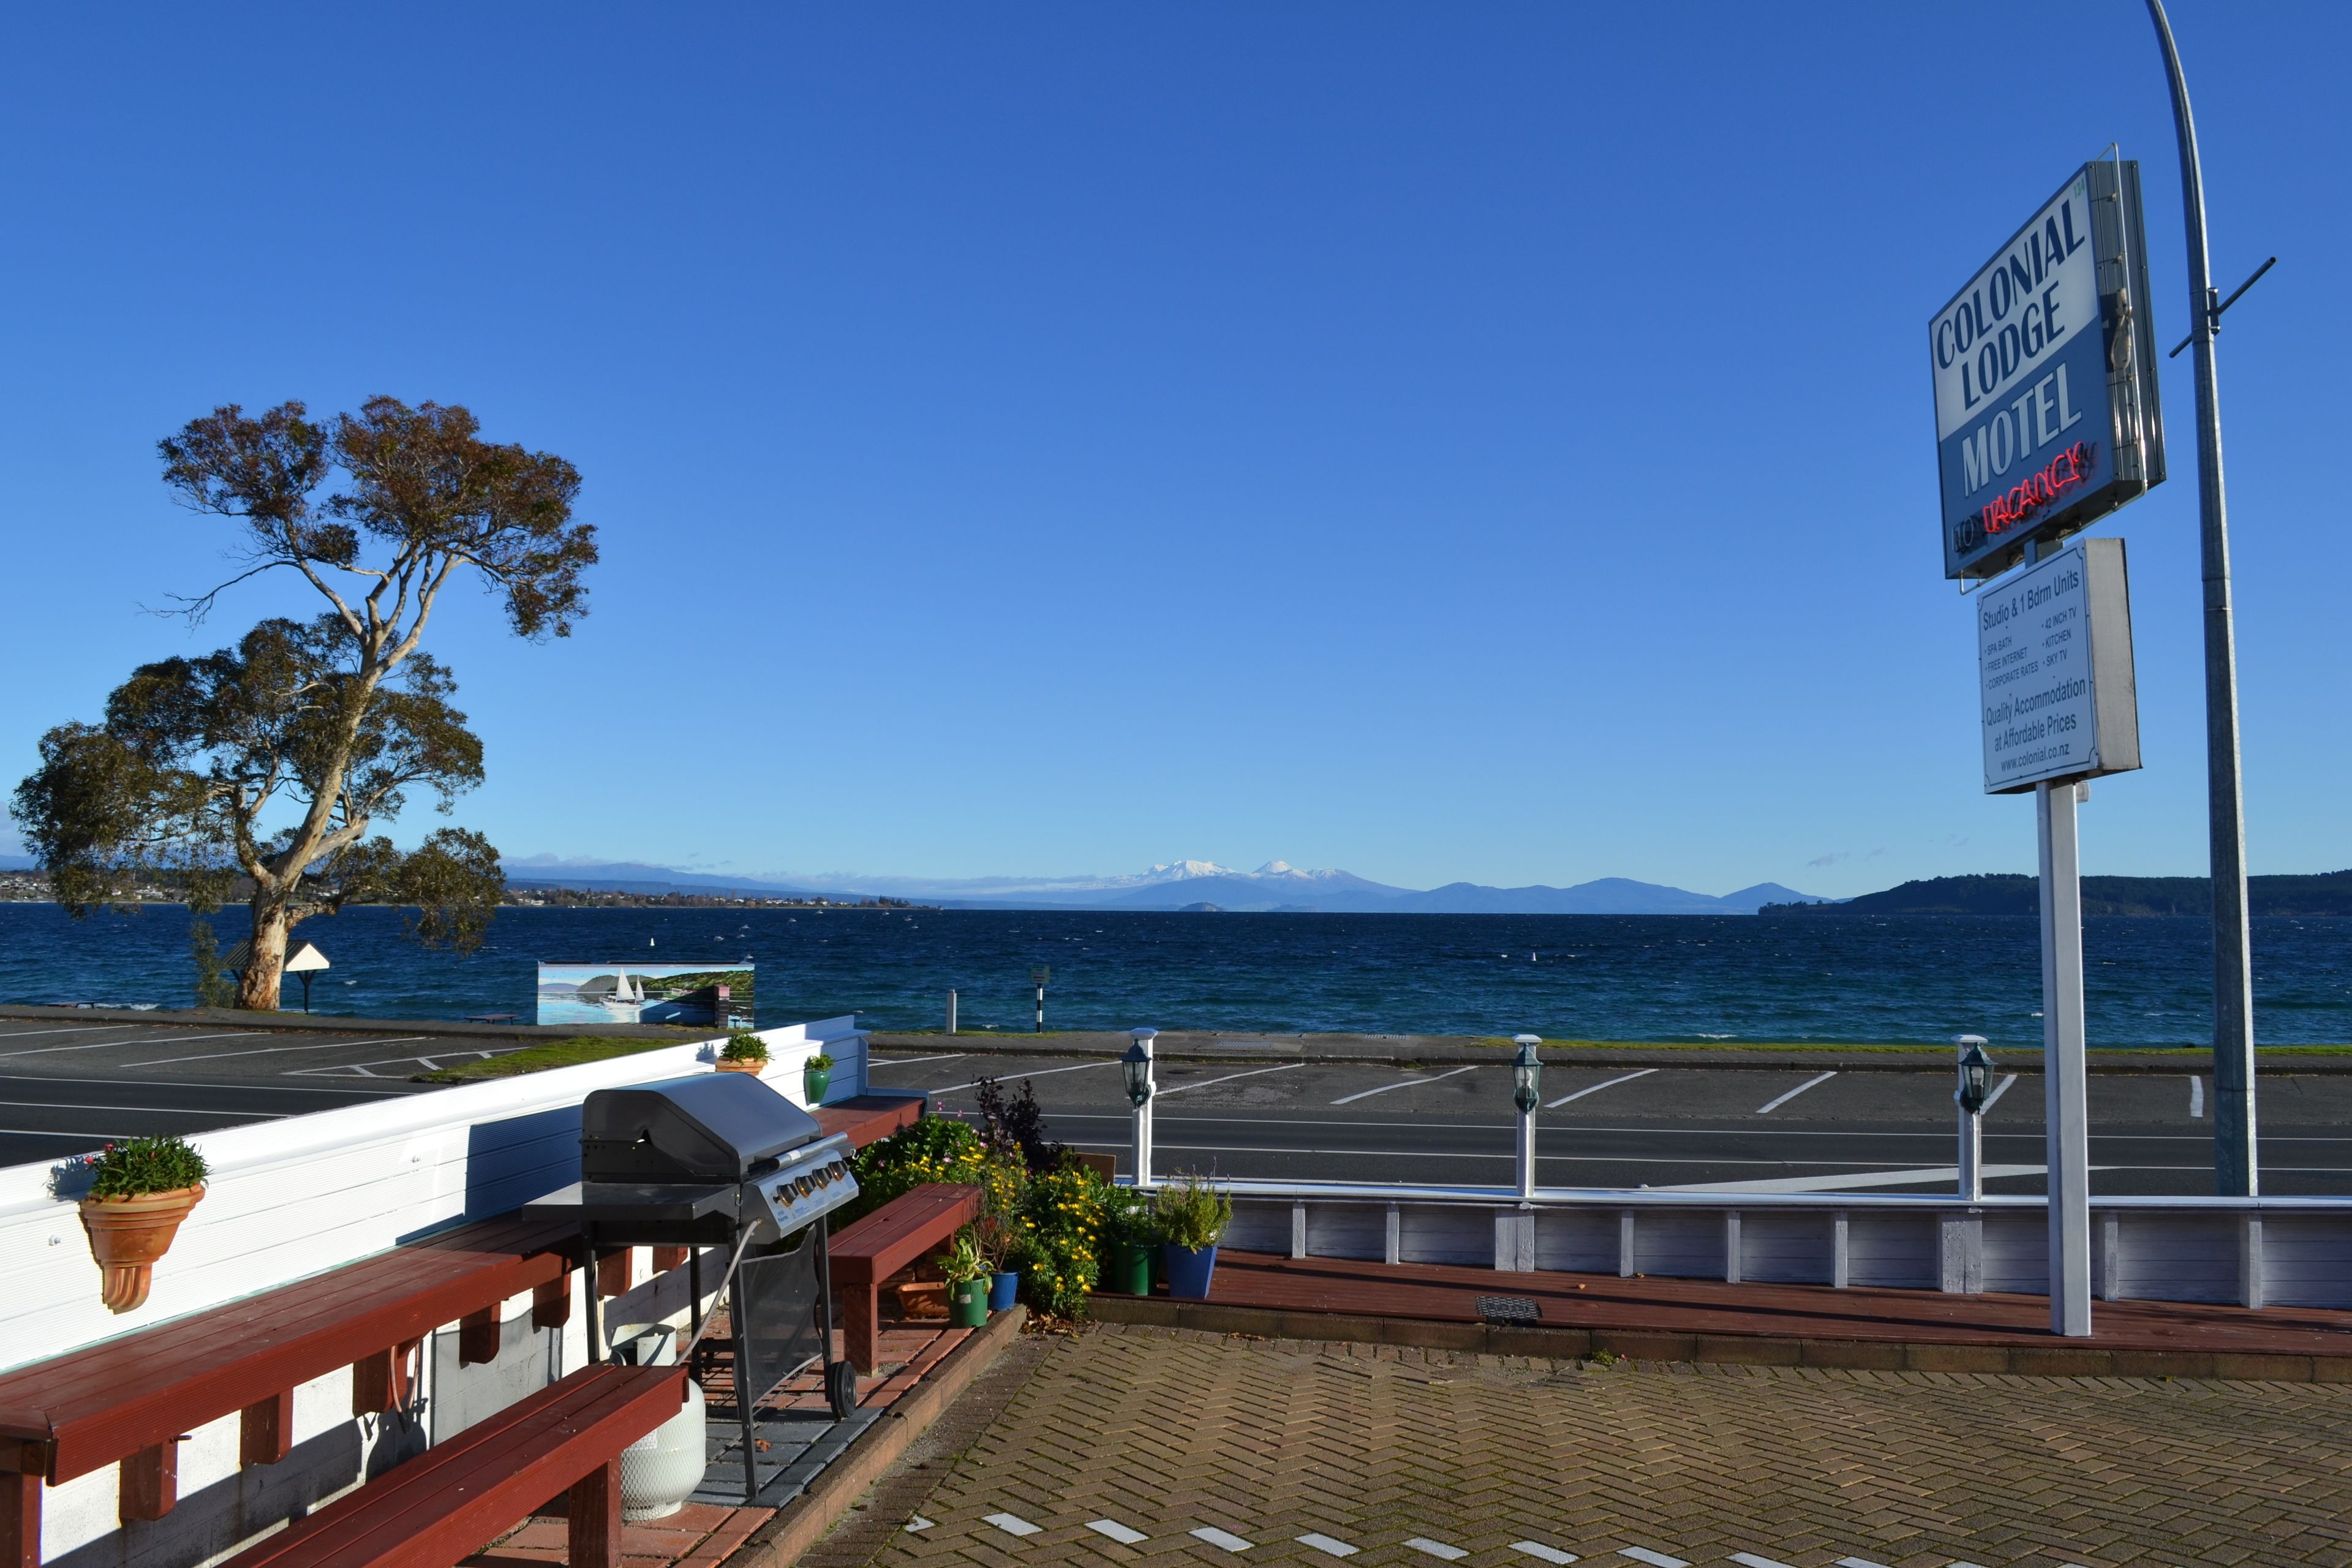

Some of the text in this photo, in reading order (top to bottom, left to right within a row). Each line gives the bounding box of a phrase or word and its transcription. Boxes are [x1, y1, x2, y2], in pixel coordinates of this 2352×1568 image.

[2073, 178, 2086, 199] 134
[1937, 198, 2085, 369] COLONIAL
[1962, 281, 2065, 411] LODGE
[1962, 362, 2082, 498] MOTEL
[1983, 441, 2084, 533] VACANCY
[1983, 570, 2079, 631] Studio & 1 Bdrm Units
[2045, 606, 2076, 629] 42 INCH TV
[1987, 636, 2012, 655] SPA BATH
[2045, 628, 2071, 649] KITCHEN
[1988, 647, 2027, 673] FREE INTERNET
[2046, 649, 2067, 667] SKY TV
[1988, 661, 2038, 690] CORPORATE RATES
[1986, 677, 2086, 726] Quality Accommodation
[1994, 713, 2076, 752] at Affordable Prices
[2001, 744, 2070, 772] www.colonial.co.nz
